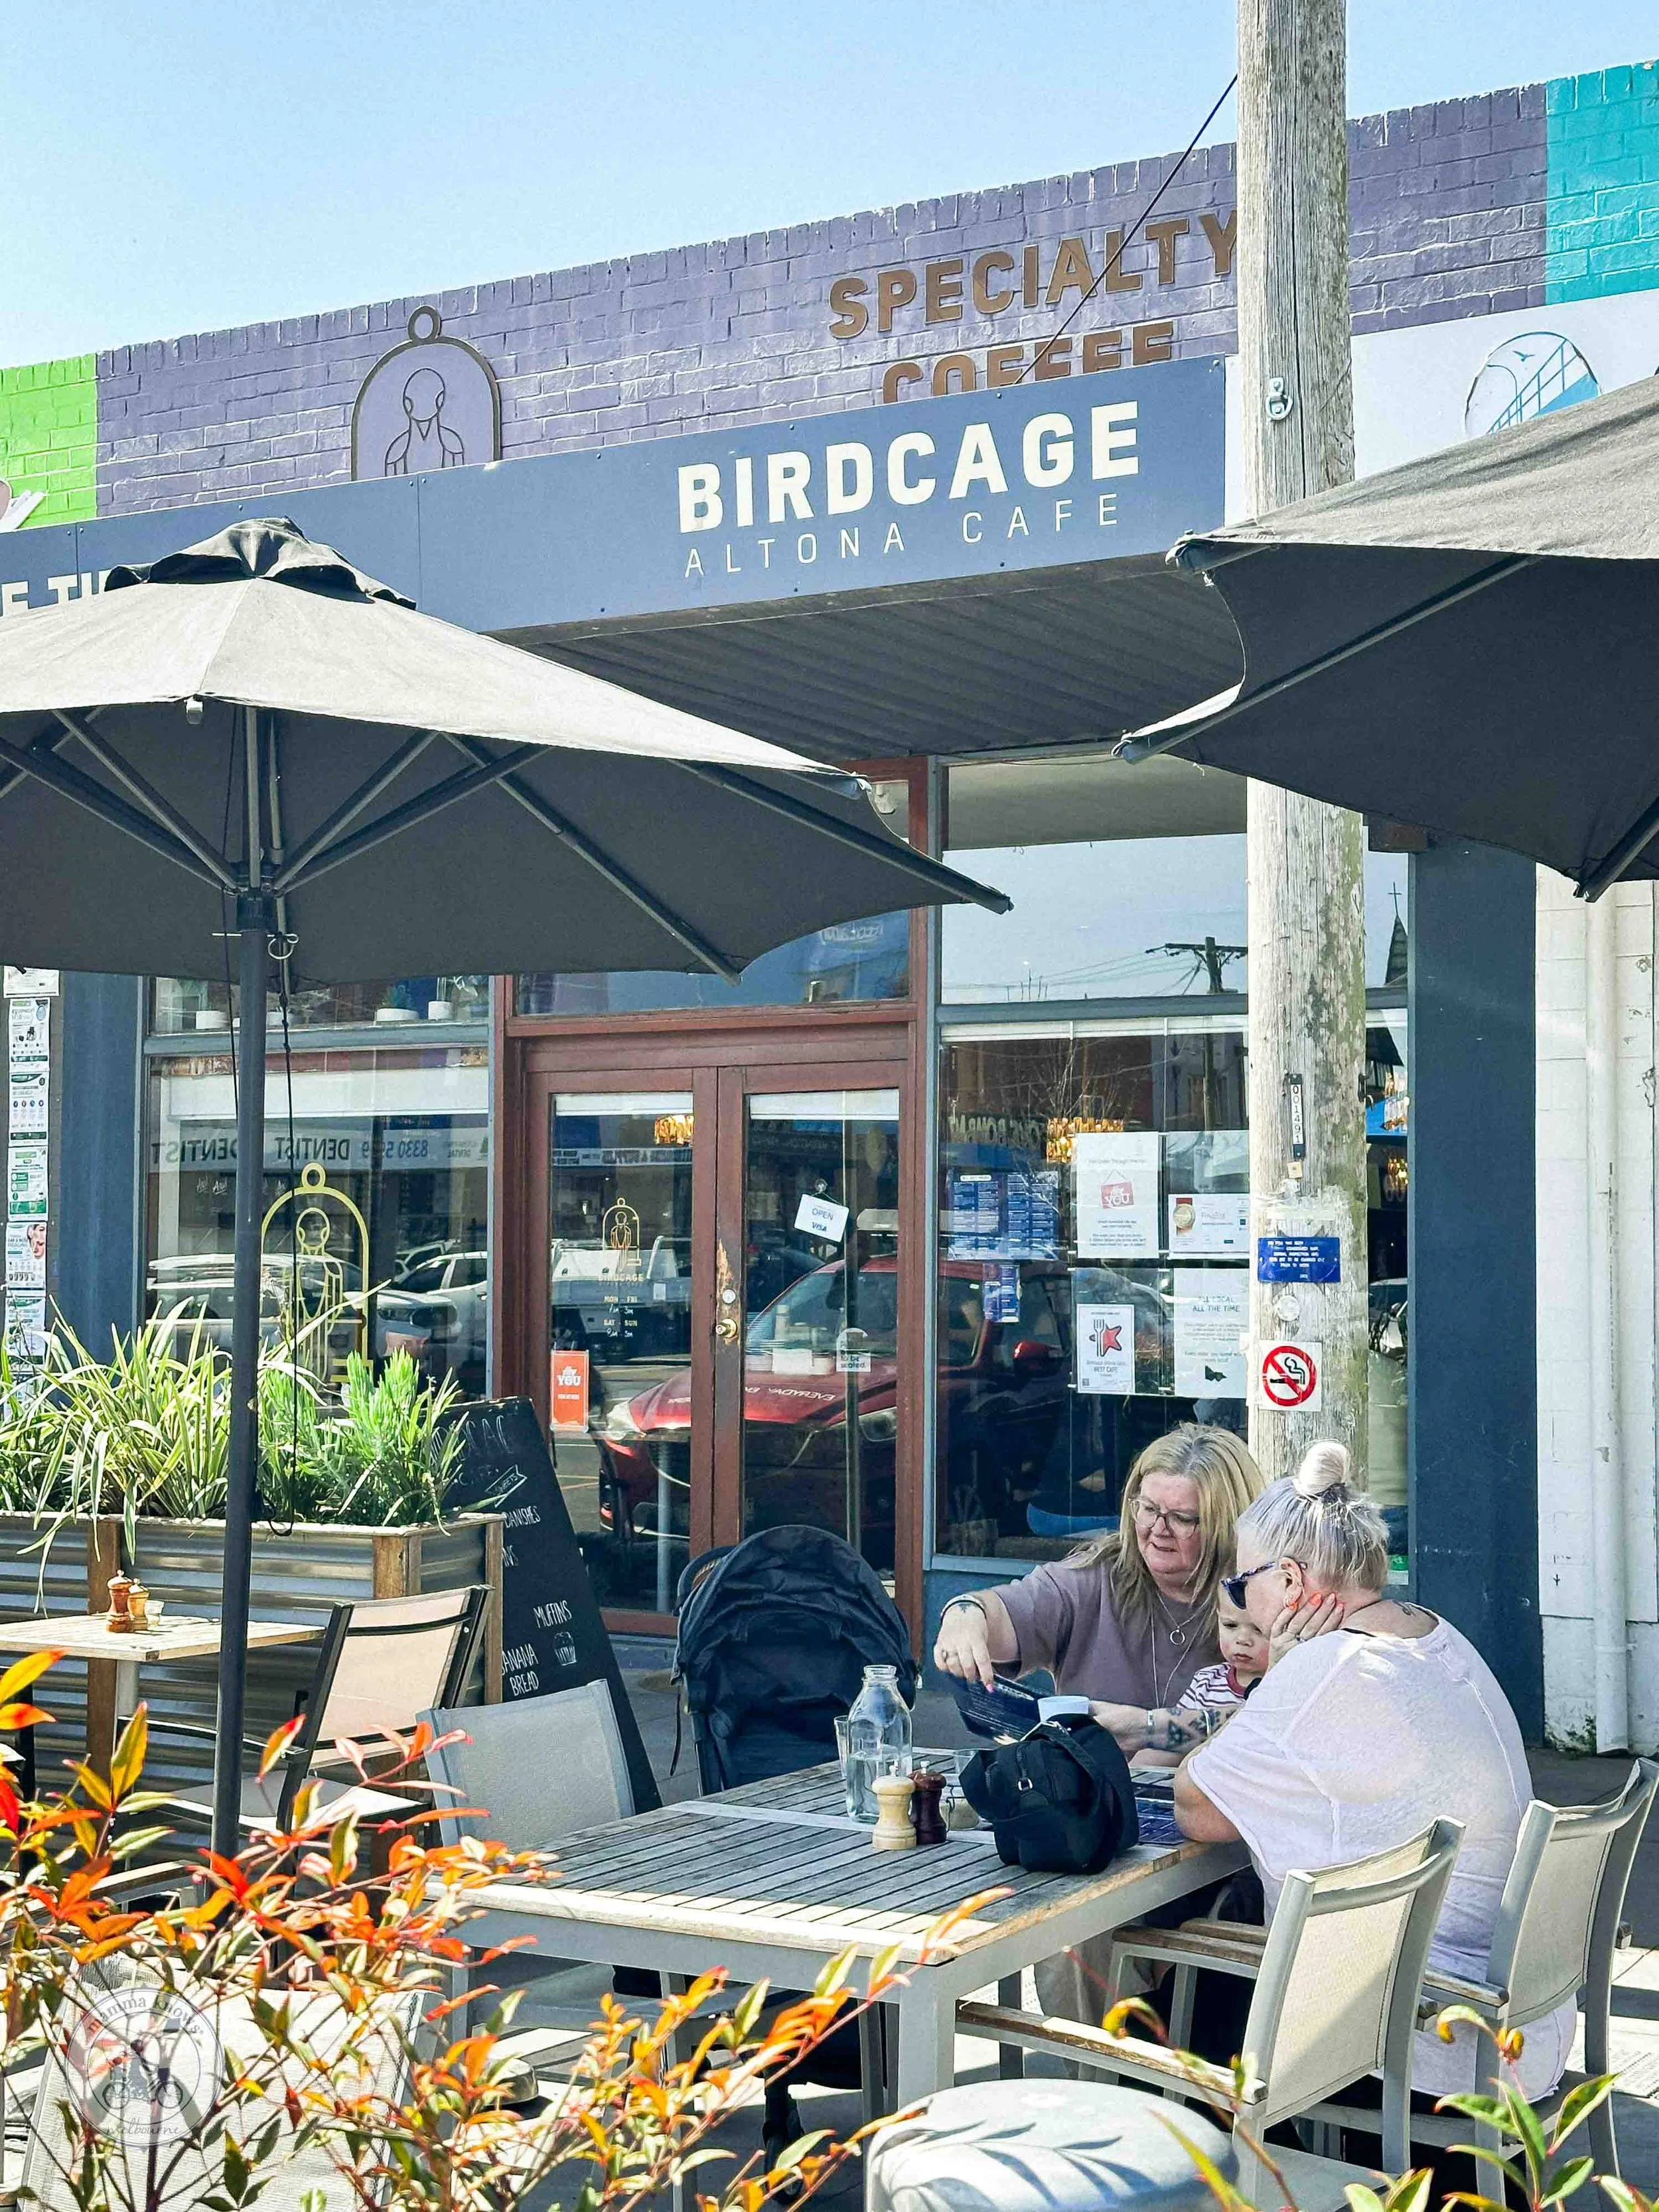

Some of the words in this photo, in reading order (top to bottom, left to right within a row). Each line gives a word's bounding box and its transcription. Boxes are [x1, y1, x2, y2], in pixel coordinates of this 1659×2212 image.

[829, 210, 1237, 339] SPECIALTY
[678, 400, 1140, 534] BIRDCAGE
[684, 522, 905, 579] ALTONA
[962, 492, 1118, 544] CAFE
[812, 1208, 833, 1221] OPEN
[812, 1222, 827, 1231] VISA
[604, 1295, 618, 1304] MON
[557, 1375, 581, 1387] YOU
[504, 1505, 541, 1529] DANISHES
[532, 1599, 572, 1629] MUFFINS
[509, 1670, 540, 1696] BREAD
